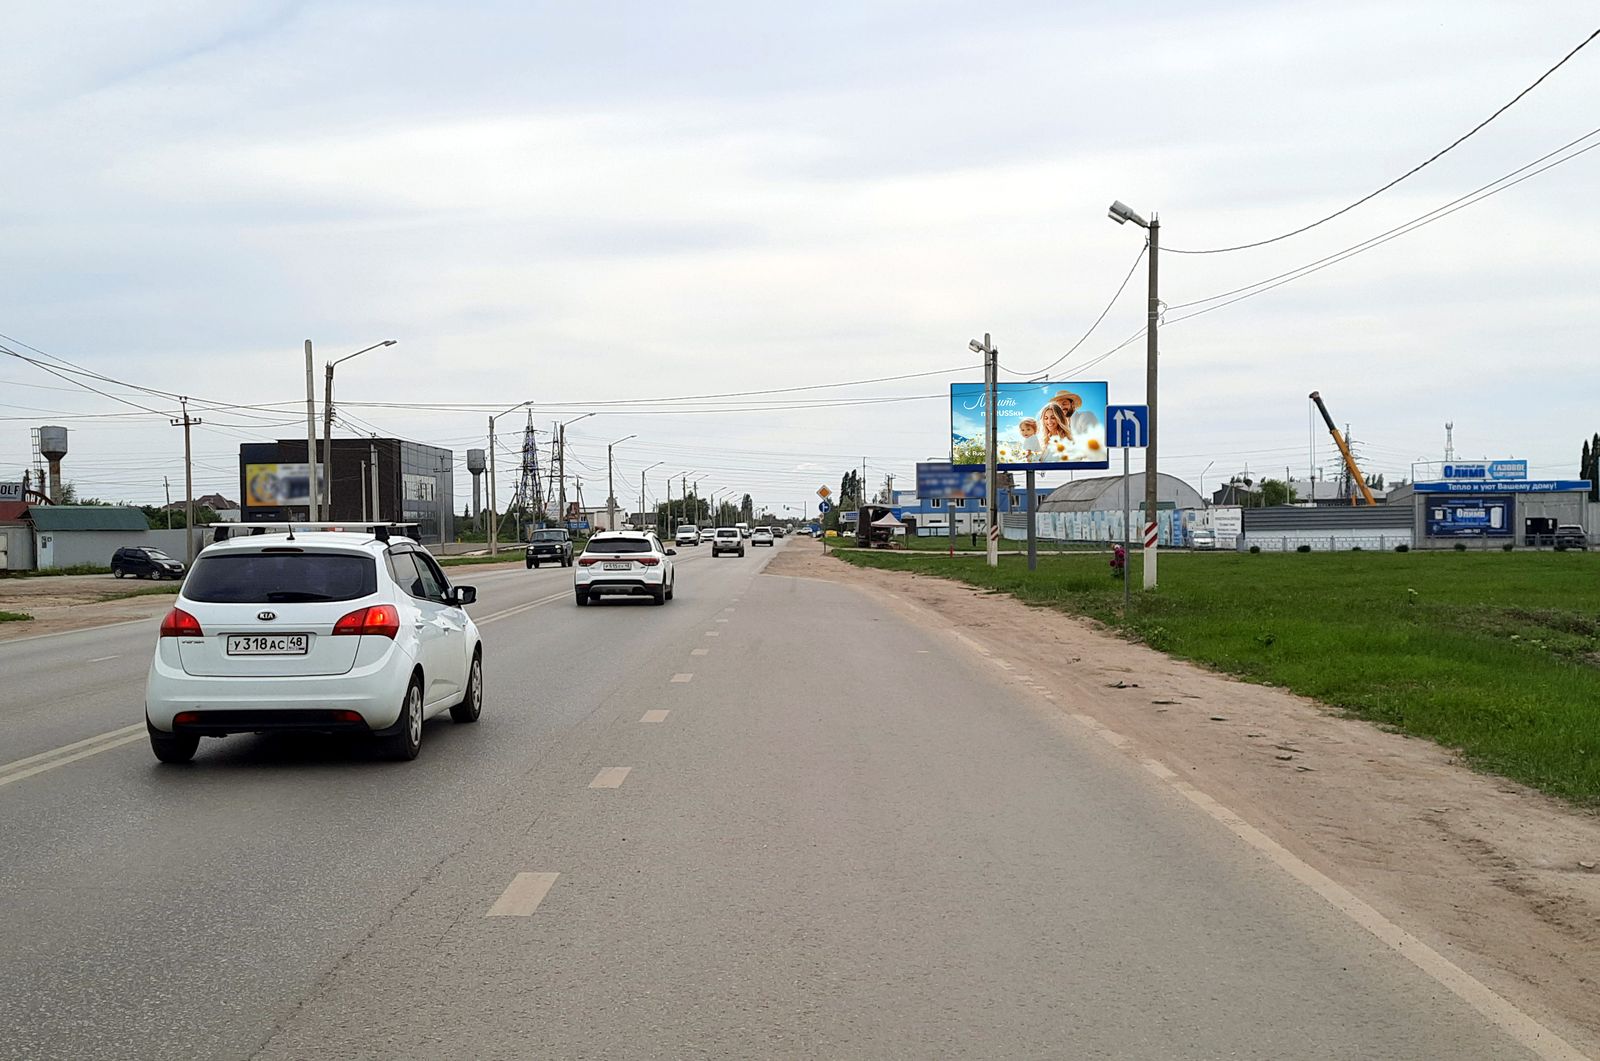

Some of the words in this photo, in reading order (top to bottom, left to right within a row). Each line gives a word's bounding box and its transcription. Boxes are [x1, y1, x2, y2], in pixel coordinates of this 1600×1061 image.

[1444, 465, 1486, 478] Олимп
[1448, 483, 1471, 491] Тепло
[1481, 484, 1496, 492] уют
[1498, 483, 1530, 491] Вашему
[234, 638, 285, 650] У318АС
[289, 637, 303, 647] 48
